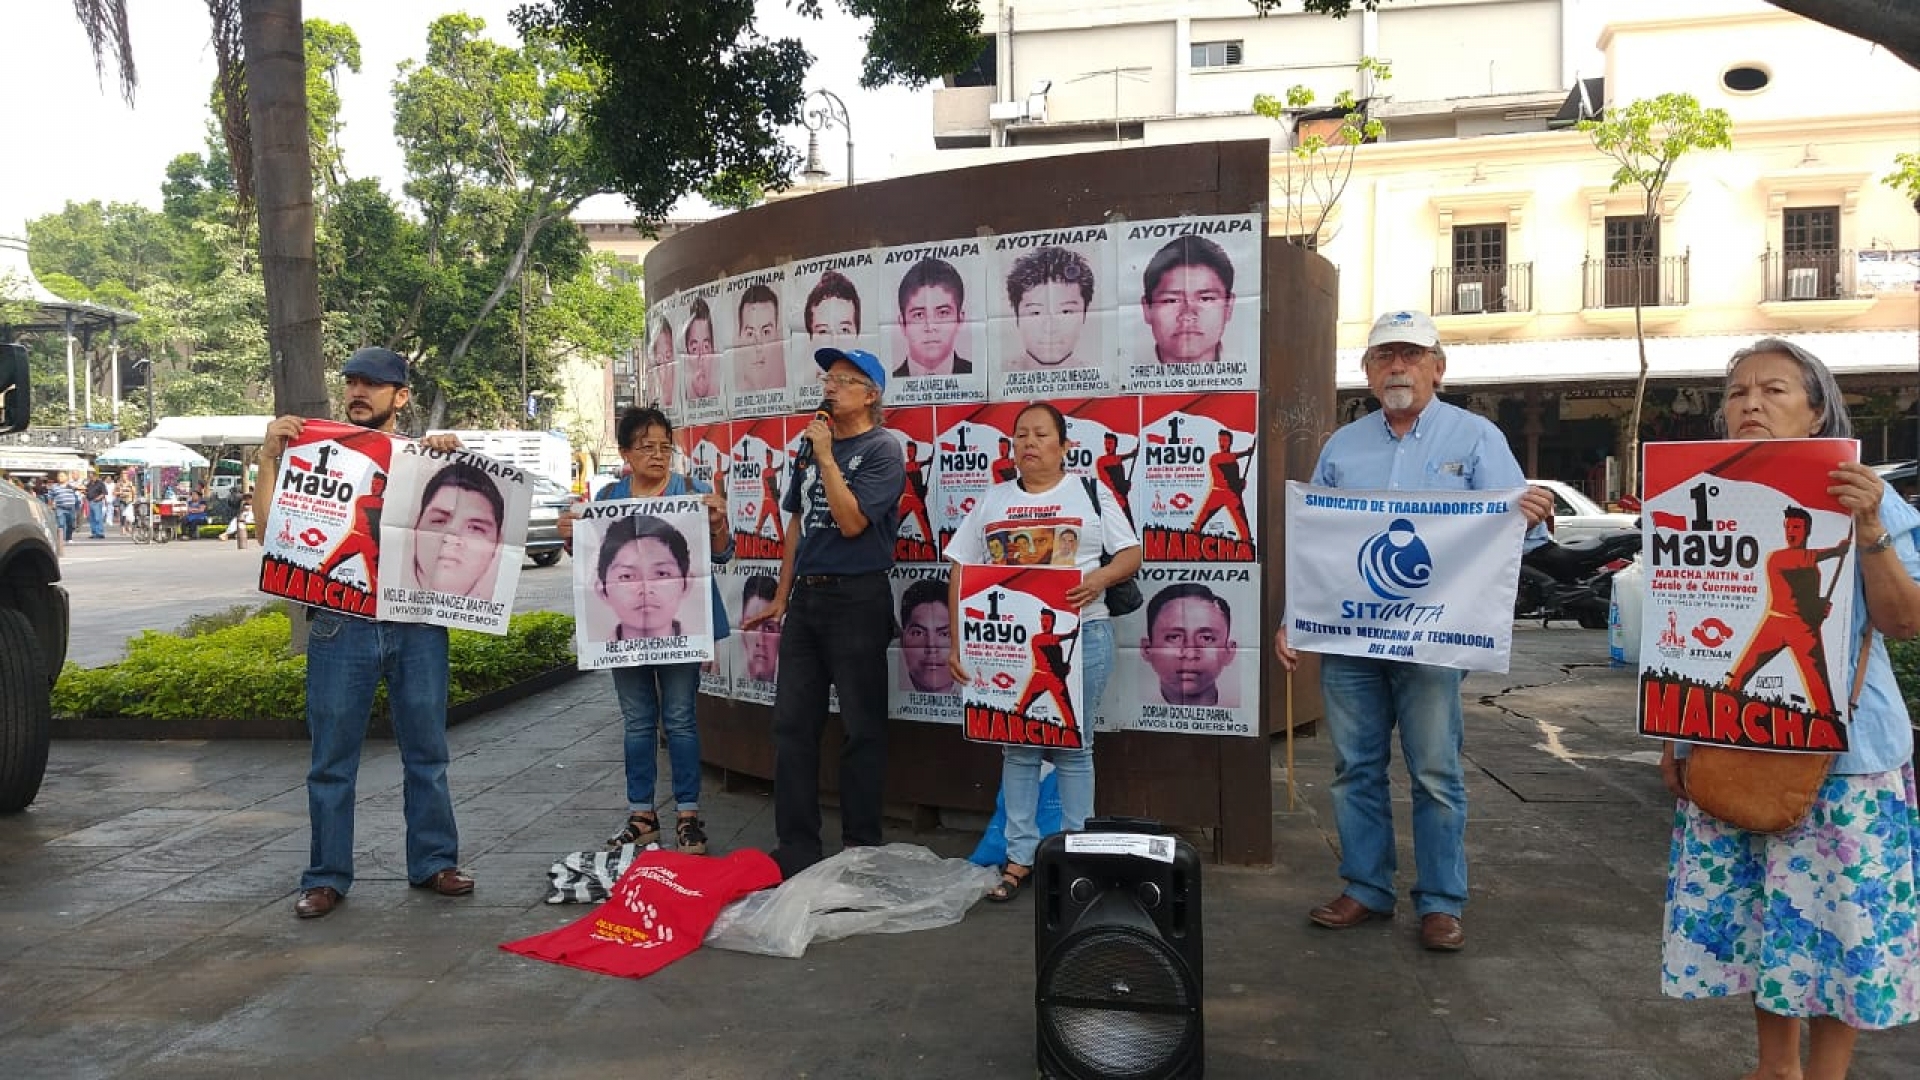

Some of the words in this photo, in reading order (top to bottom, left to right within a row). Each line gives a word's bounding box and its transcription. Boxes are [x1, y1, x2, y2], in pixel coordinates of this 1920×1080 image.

[995, 228, 1108, 250] AYOTZINAPA
[1128, 219, 1252, 240] AYOTZINAPA
[884, 243, 980, 265] AYOTZINAPA
[794, 253, 873, 277] AYOTZINAPA
[727, 269, 785, 293] AYOTZINAPA
[1037, 384, 1054, 393] LOS
[1057, 381, 1109, 392] QUEREMOS
[1165, 379, 1184, 388] LOS
[1186, 377, 1243, 388] QUEREMOS
[402, 442, 525, 484] AYOTZINAPA
[940, 452, 988, 472] Mayo
[1066, 449, 1093, 467] yo
[1145, 446, 1205, 466] Mayo
[733, 462, 760, 479] Mayo
[282, 469, 353, 503] Mayo
[582, 501, 699, 519] AYOTZINAPA
[1305, 494, 1367, 512] SINDICATO
[1370, 499, 1385, 513] DE
[1388, 500, 1483, 515] TRABAJADORES
[1486, 501, 1509, 514] DEL
[1143, 528, 1255, 562] MARCHA
[1652, 533, 1759, 569] Mayo
[733, 565, 781, 577] AYOTZINA
[890, 567, 951, 580] AYOTZIN
[1686, 581, 1697, 592] de
[1702, 581, 1758, 594] Cuernavaca
[466, 599, 505, 616] MARTINEZ
[436, 610, 499, 626] QUEREMOS
[964, 621, 1026, 644] Mayo
[1295, 618, 1351, 637] INSTITUTO
[1357, 626, 1410, 642] MEXICANO
[1412, 630, 1423, 642] DE
[1368, 643, 1386, 655] DEL
[1690, 648, 1732, 659] STUNAM
[1643, 679, 1844, 750] MARCHA
[967, 706, 1079, 747] MARCHA
[1169, 720, 1188, 730] LOS
[1191, 722, 1248, 733] QUEREMOS
